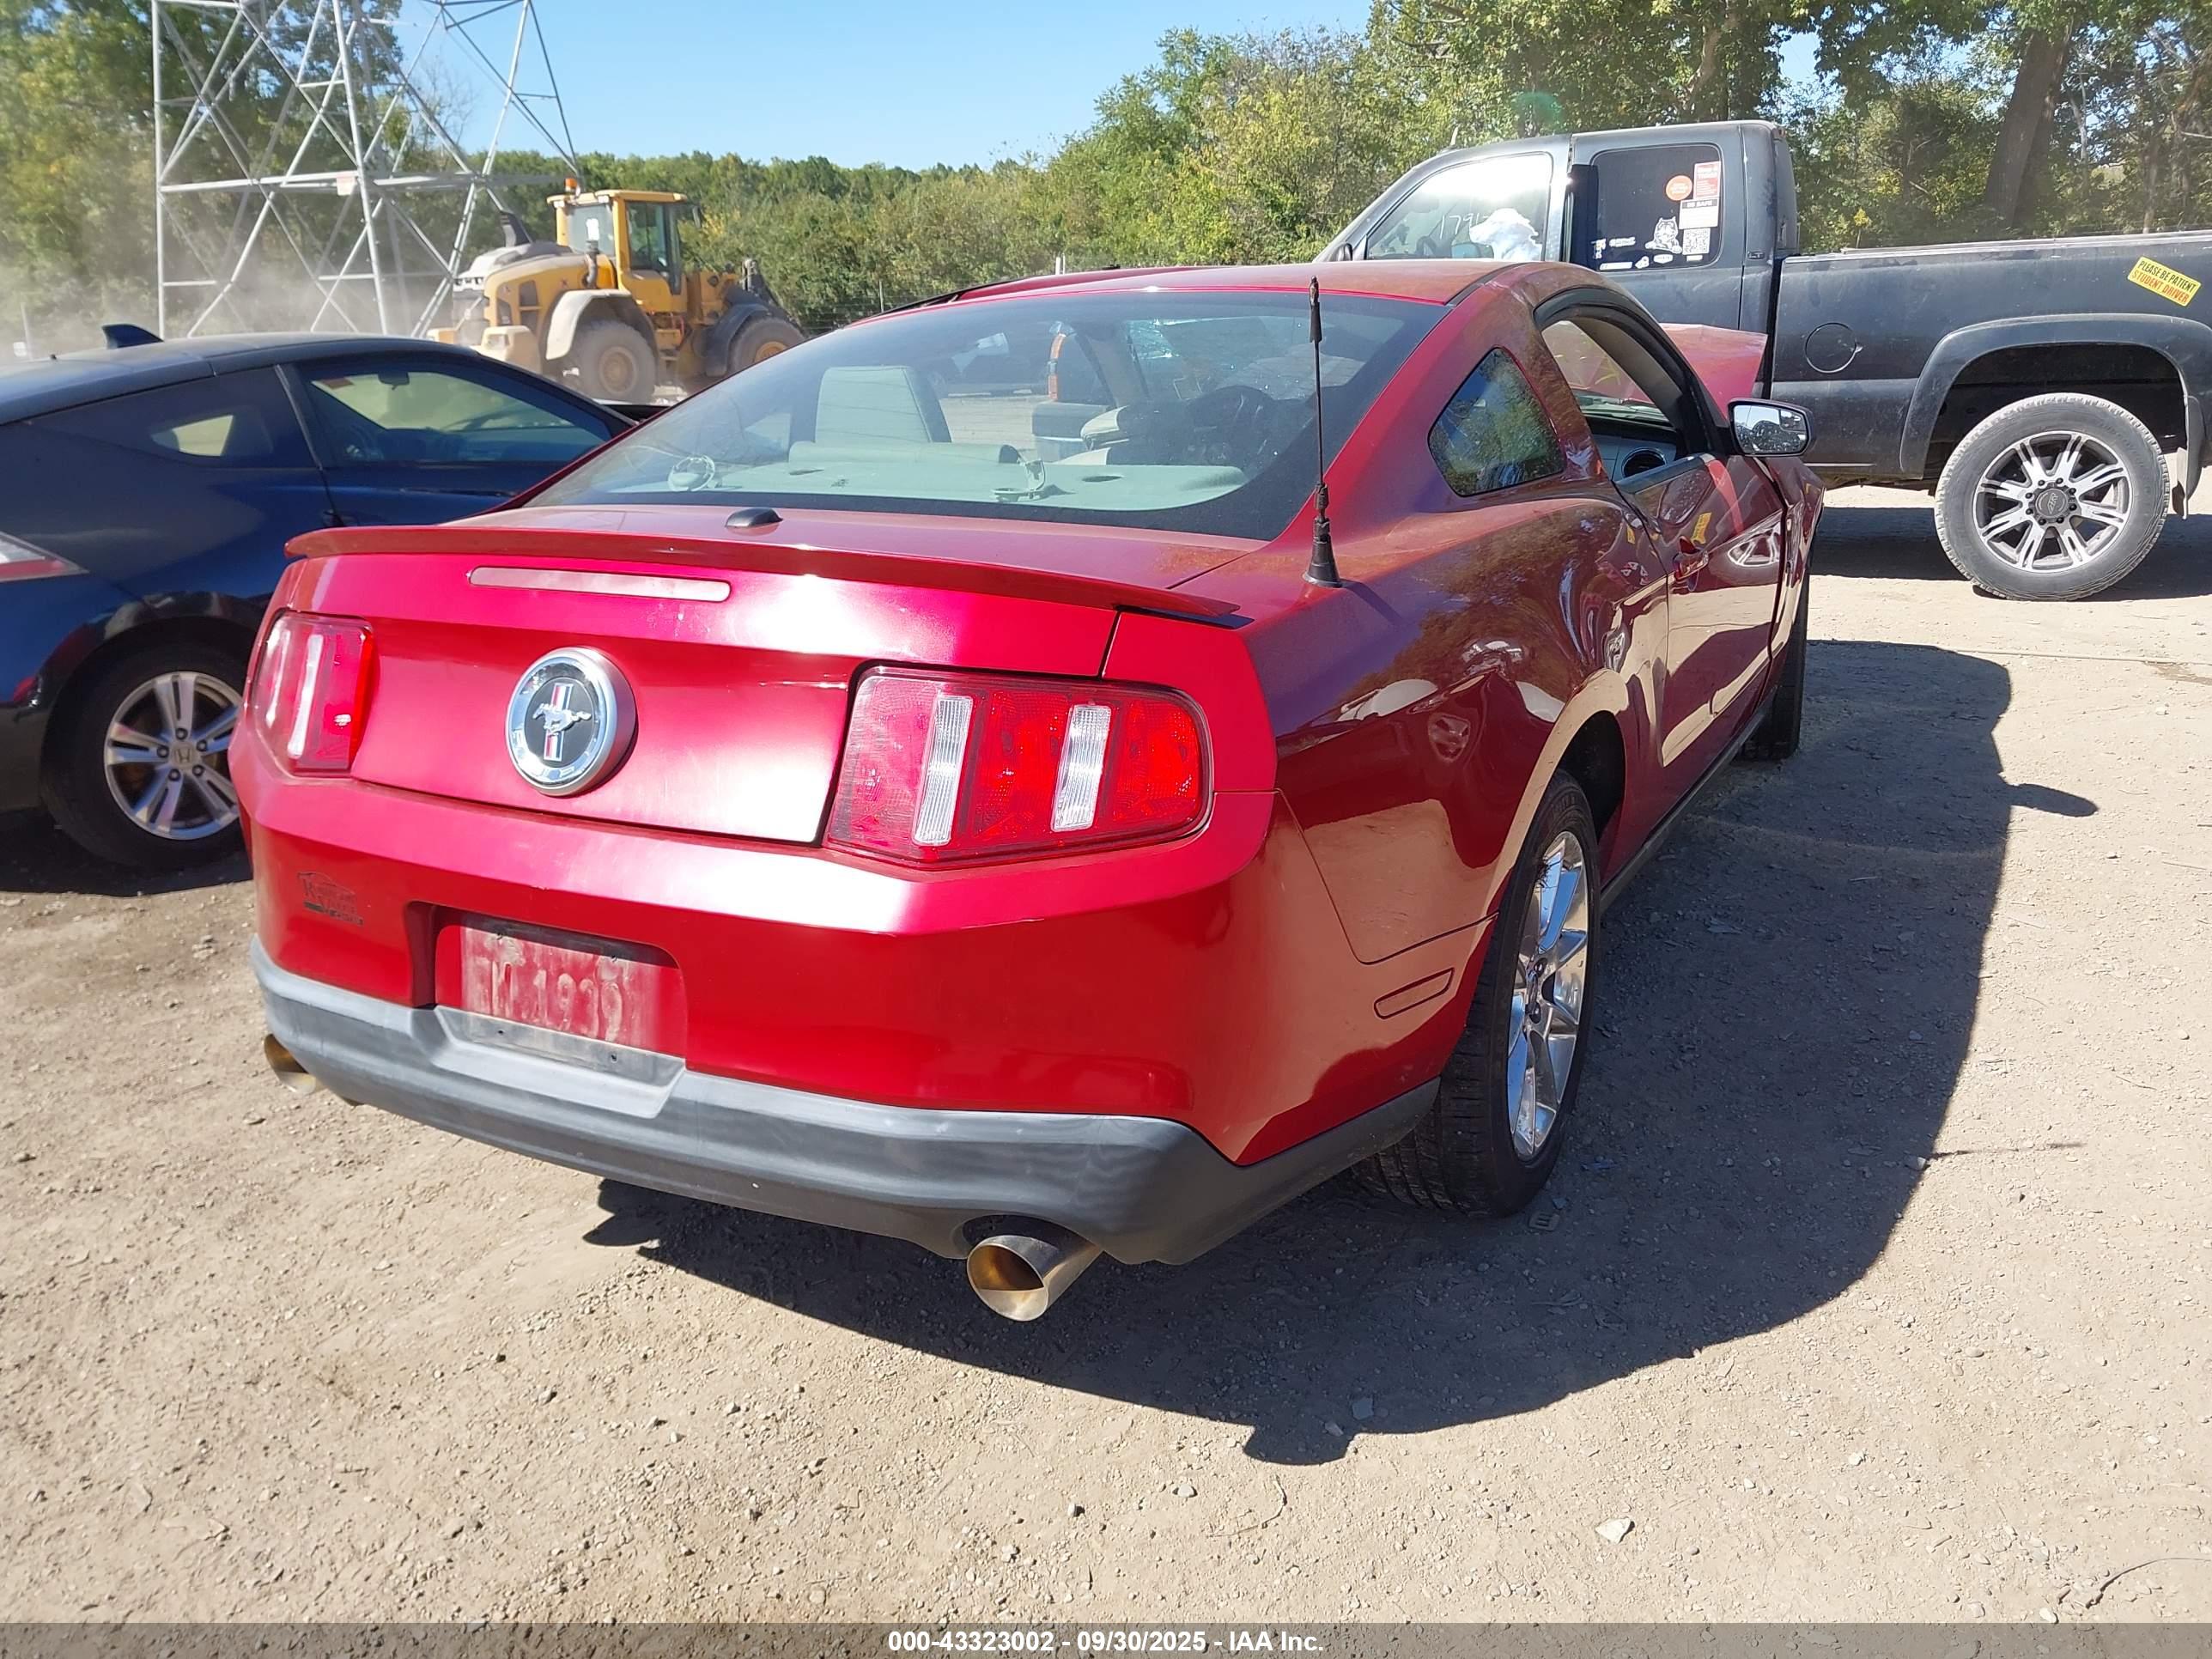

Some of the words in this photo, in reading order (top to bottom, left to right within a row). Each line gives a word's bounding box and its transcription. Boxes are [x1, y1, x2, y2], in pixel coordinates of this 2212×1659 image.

[2132, 270, 2163, 290] STUDENT
[2162, 285, 2190, 304] DRIVER
[2137, 260, 2161, 276] PLEASE
[2160, 270, 2170, 281] BE
[2168, 275, 2197, 294] PATIENT
